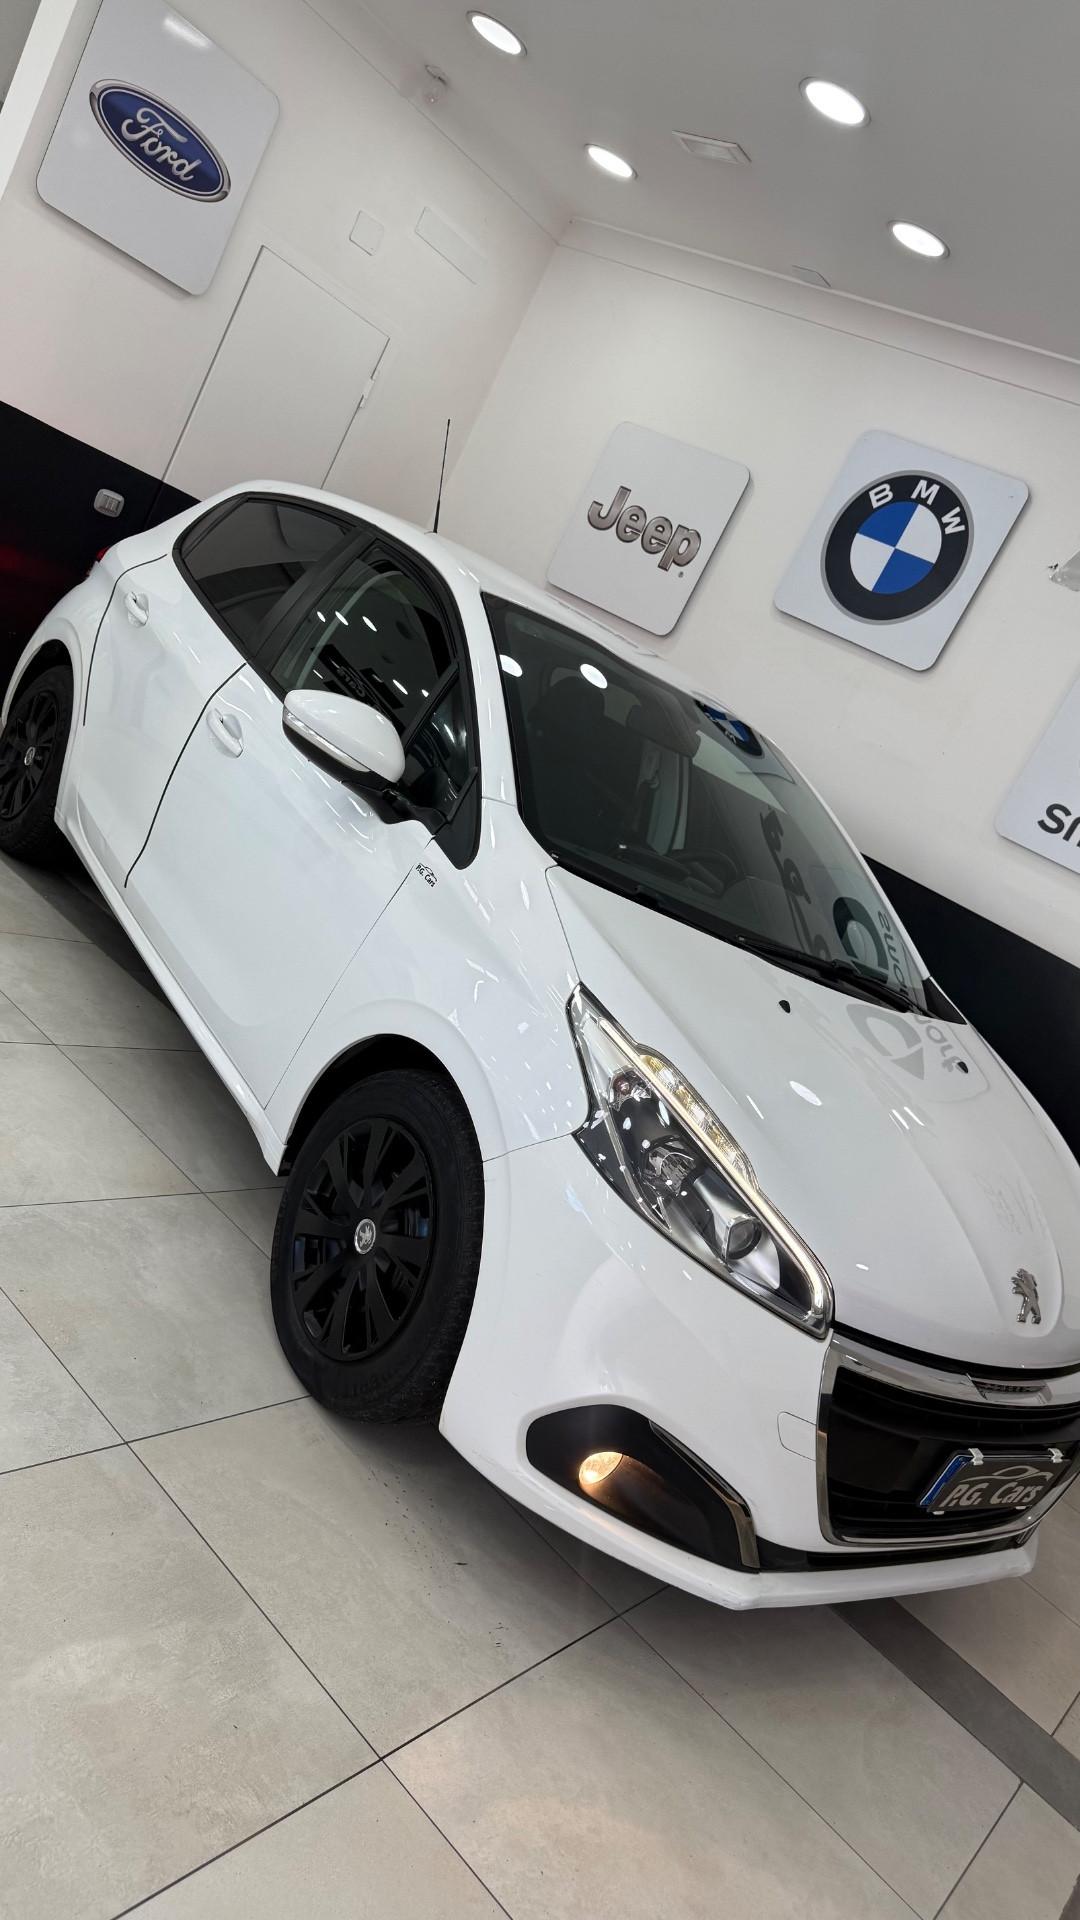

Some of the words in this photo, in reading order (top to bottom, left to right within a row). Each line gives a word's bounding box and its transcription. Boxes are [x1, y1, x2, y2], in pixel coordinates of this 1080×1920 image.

[121, 107, 202, 181] Ford
[587, 485, 702, 572] Jeep
[868, 479, 966, 535] BMW
[424, 874, 436, 888] Cars
[939, 1482, 989, 1507] P.G.
[989, 1481, 1044, 1505] Cars
